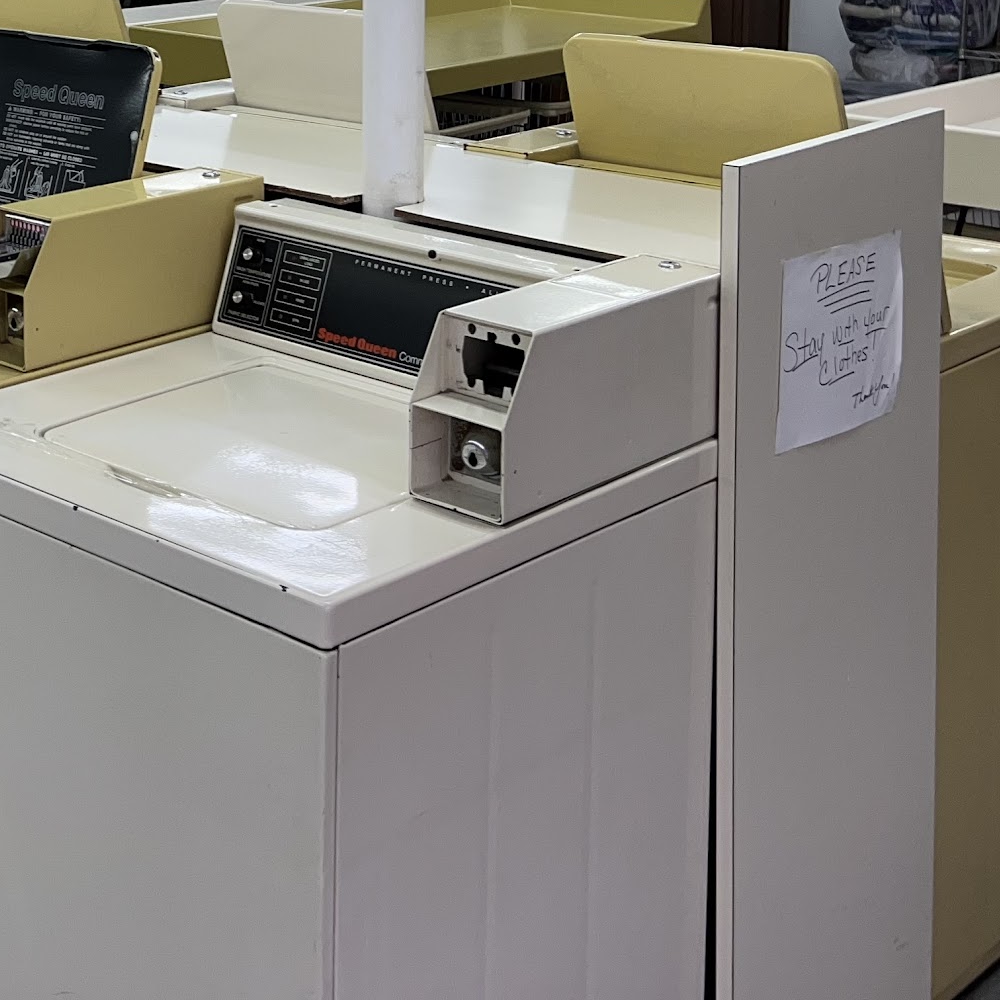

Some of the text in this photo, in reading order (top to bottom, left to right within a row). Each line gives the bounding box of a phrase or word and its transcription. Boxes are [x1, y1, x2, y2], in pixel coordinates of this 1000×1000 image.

[12, 78, 105, 110] Speed Queen
[354, 258, 500, 296] PERMANENT PRESS AL
[810, 252, 876, 294] PLEASE
[317, 327, 357, 348] Speed
[357, 337, 398, 359] Queen
[784, 305, 890, 373] Stay with your
